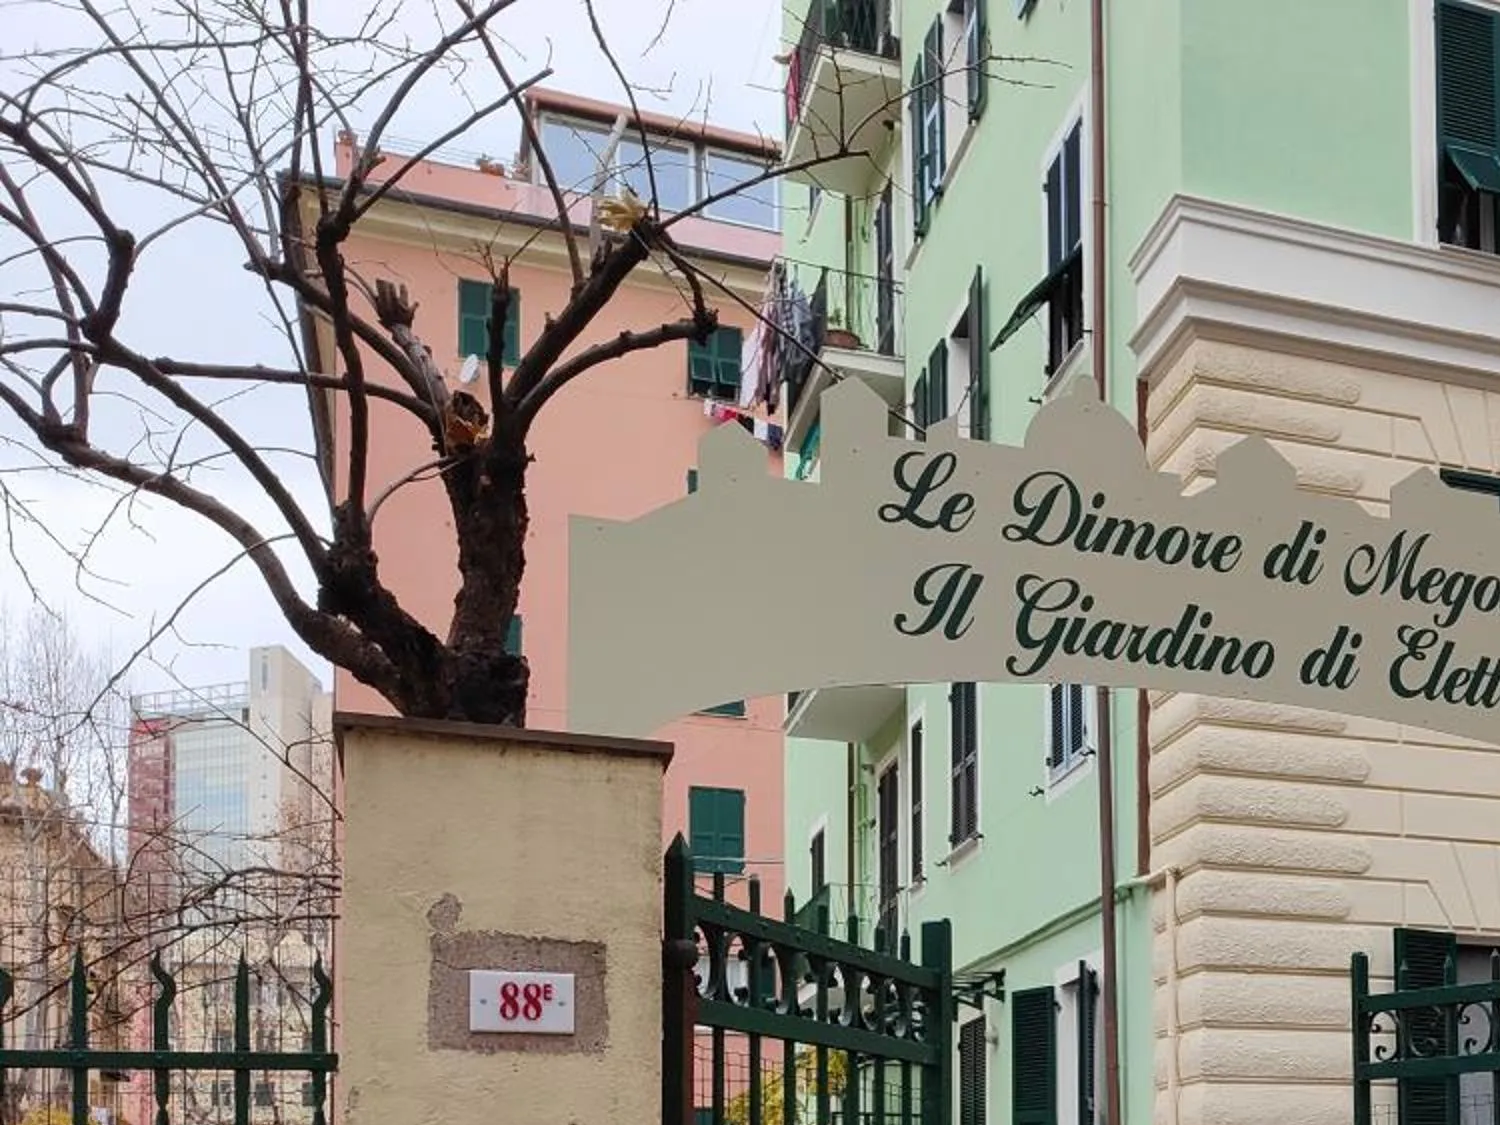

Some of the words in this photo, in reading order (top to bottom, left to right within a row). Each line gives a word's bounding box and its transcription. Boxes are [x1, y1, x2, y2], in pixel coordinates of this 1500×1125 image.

[877, 451, 976, 533] Le
[1001, 471, 1243, 573] Dimore
[1263, 520, 1327, 586] di
[893, 563, 985, 641] Il
[1005, 573, 1275, 679] Giardino
[1299, 625, 1363, 691] di
